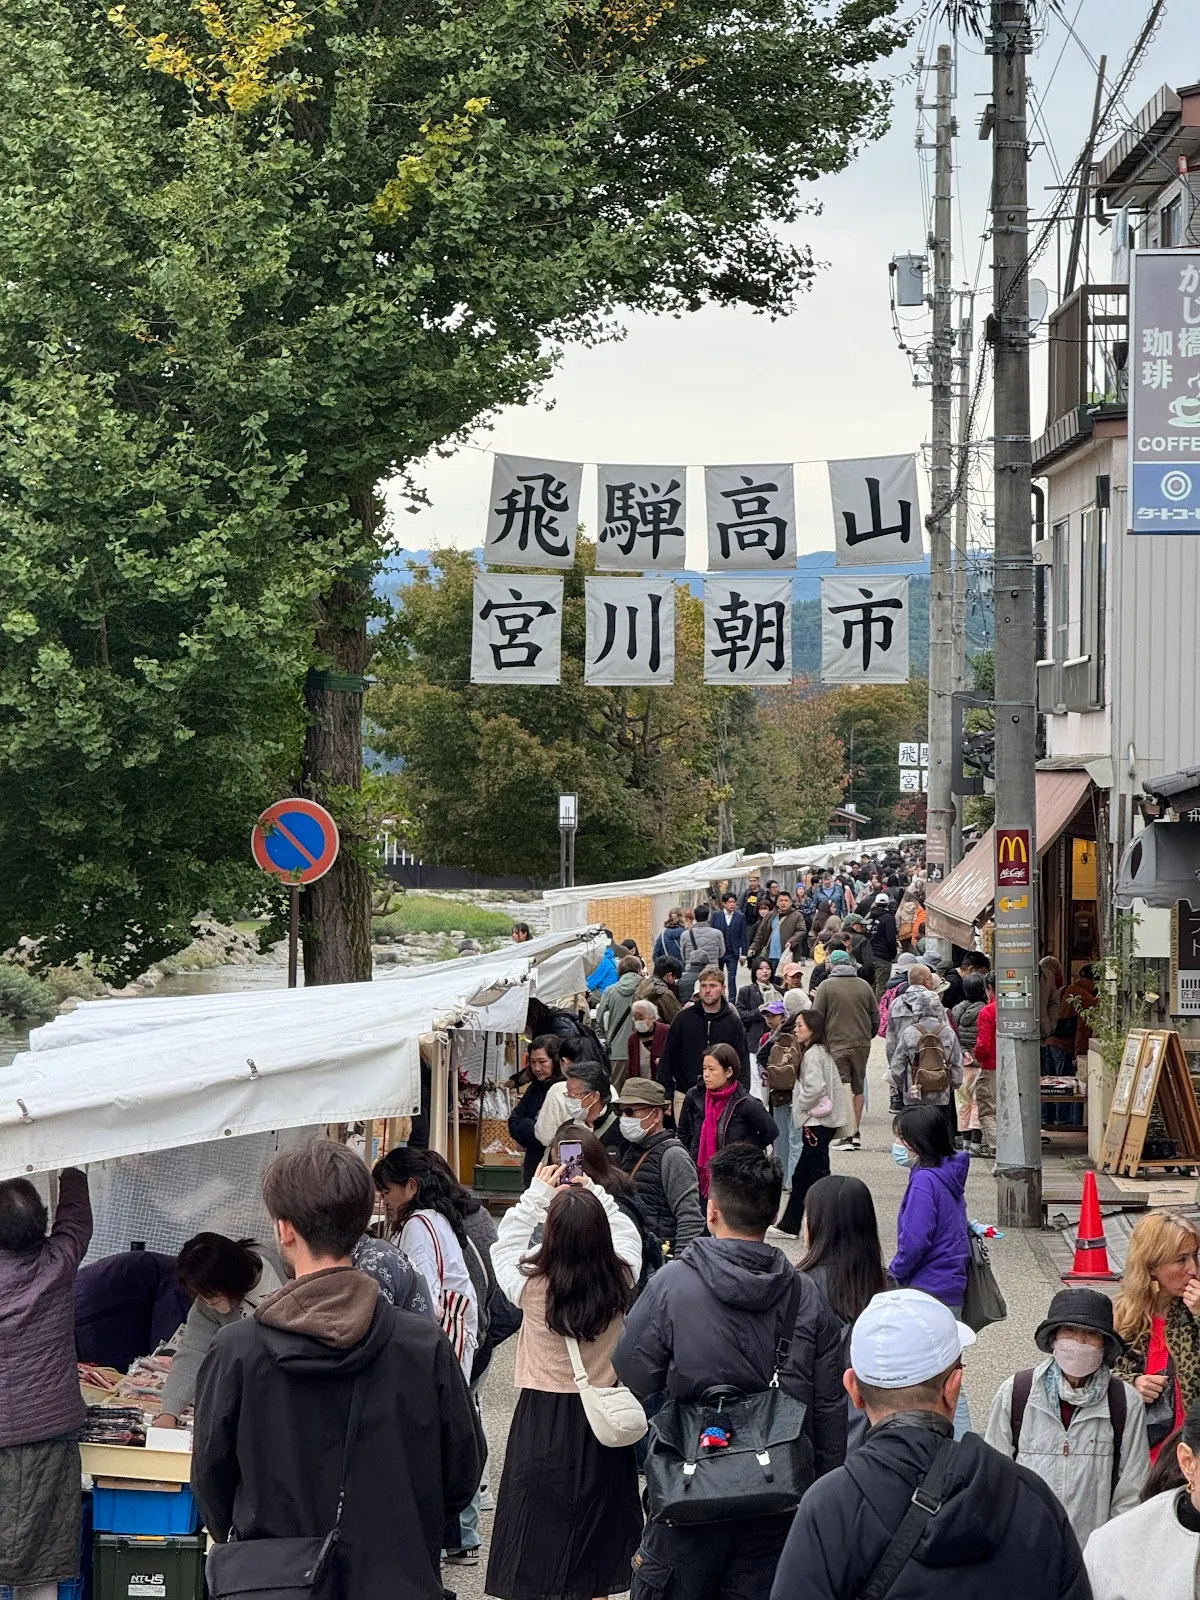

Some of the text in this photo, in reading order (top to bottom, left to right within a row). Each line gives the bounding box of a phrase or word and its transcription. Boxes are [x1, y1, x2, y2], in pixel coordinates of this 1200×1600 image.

[1142, 327, 1173, 389] 珈琲
[490, 473, 911, 561] 飛騨高山
[479, 587, 904, 673] 宮川朝市
[1170, 965, 1178, 991] MARKET
[1002, 1021, 1027, 1029] 下三之町
